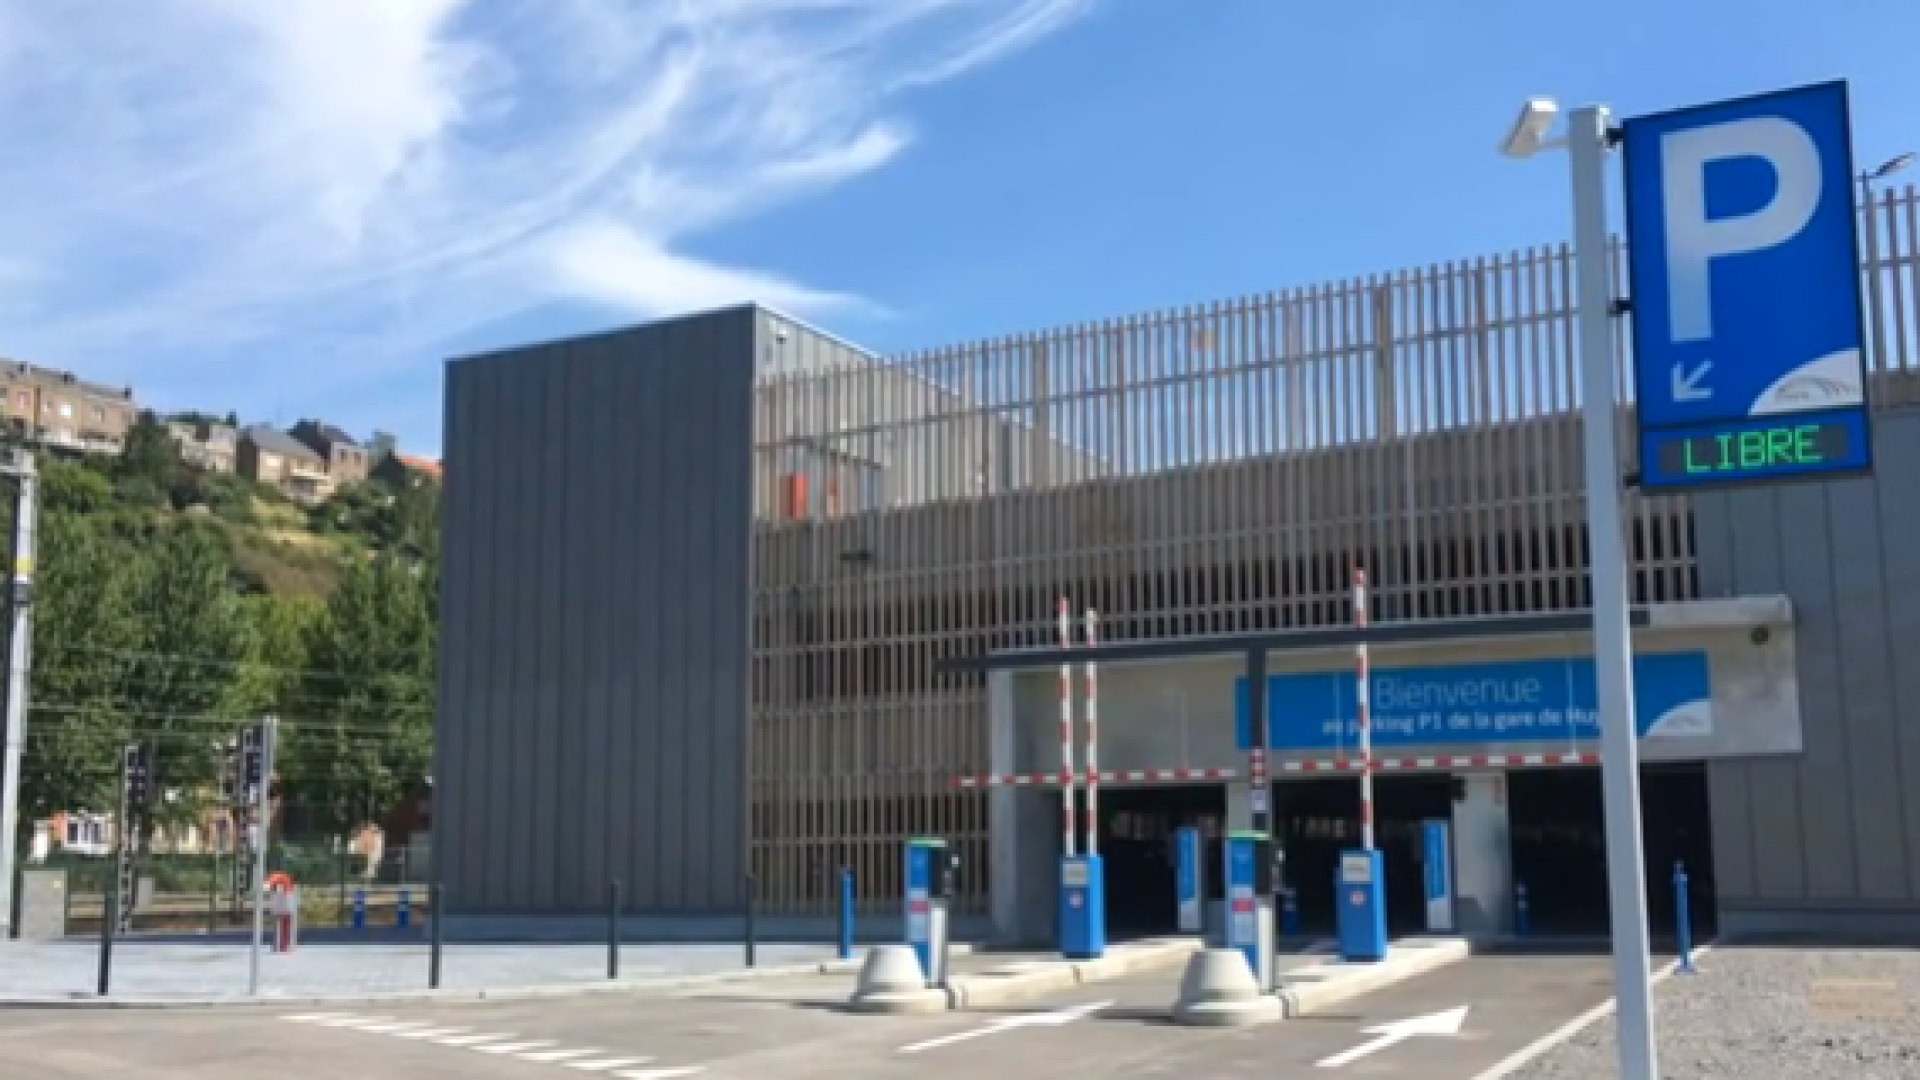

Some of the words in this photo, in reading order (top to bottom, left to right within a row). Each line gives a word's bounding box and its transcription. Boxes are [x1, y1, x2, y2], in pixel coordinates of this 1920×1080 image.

[1660, 115, 1823, 343] P
[1684, 424, 1824, 474] LIBRE
[1376, 676, 1541, 708] Bienvenue
[1348, 714, 1415, 737] prking
[1419, 712, 1442, 730] P1
[1494, 710, 1533, 733] gare
[1538, 707, 1562, 726] de
